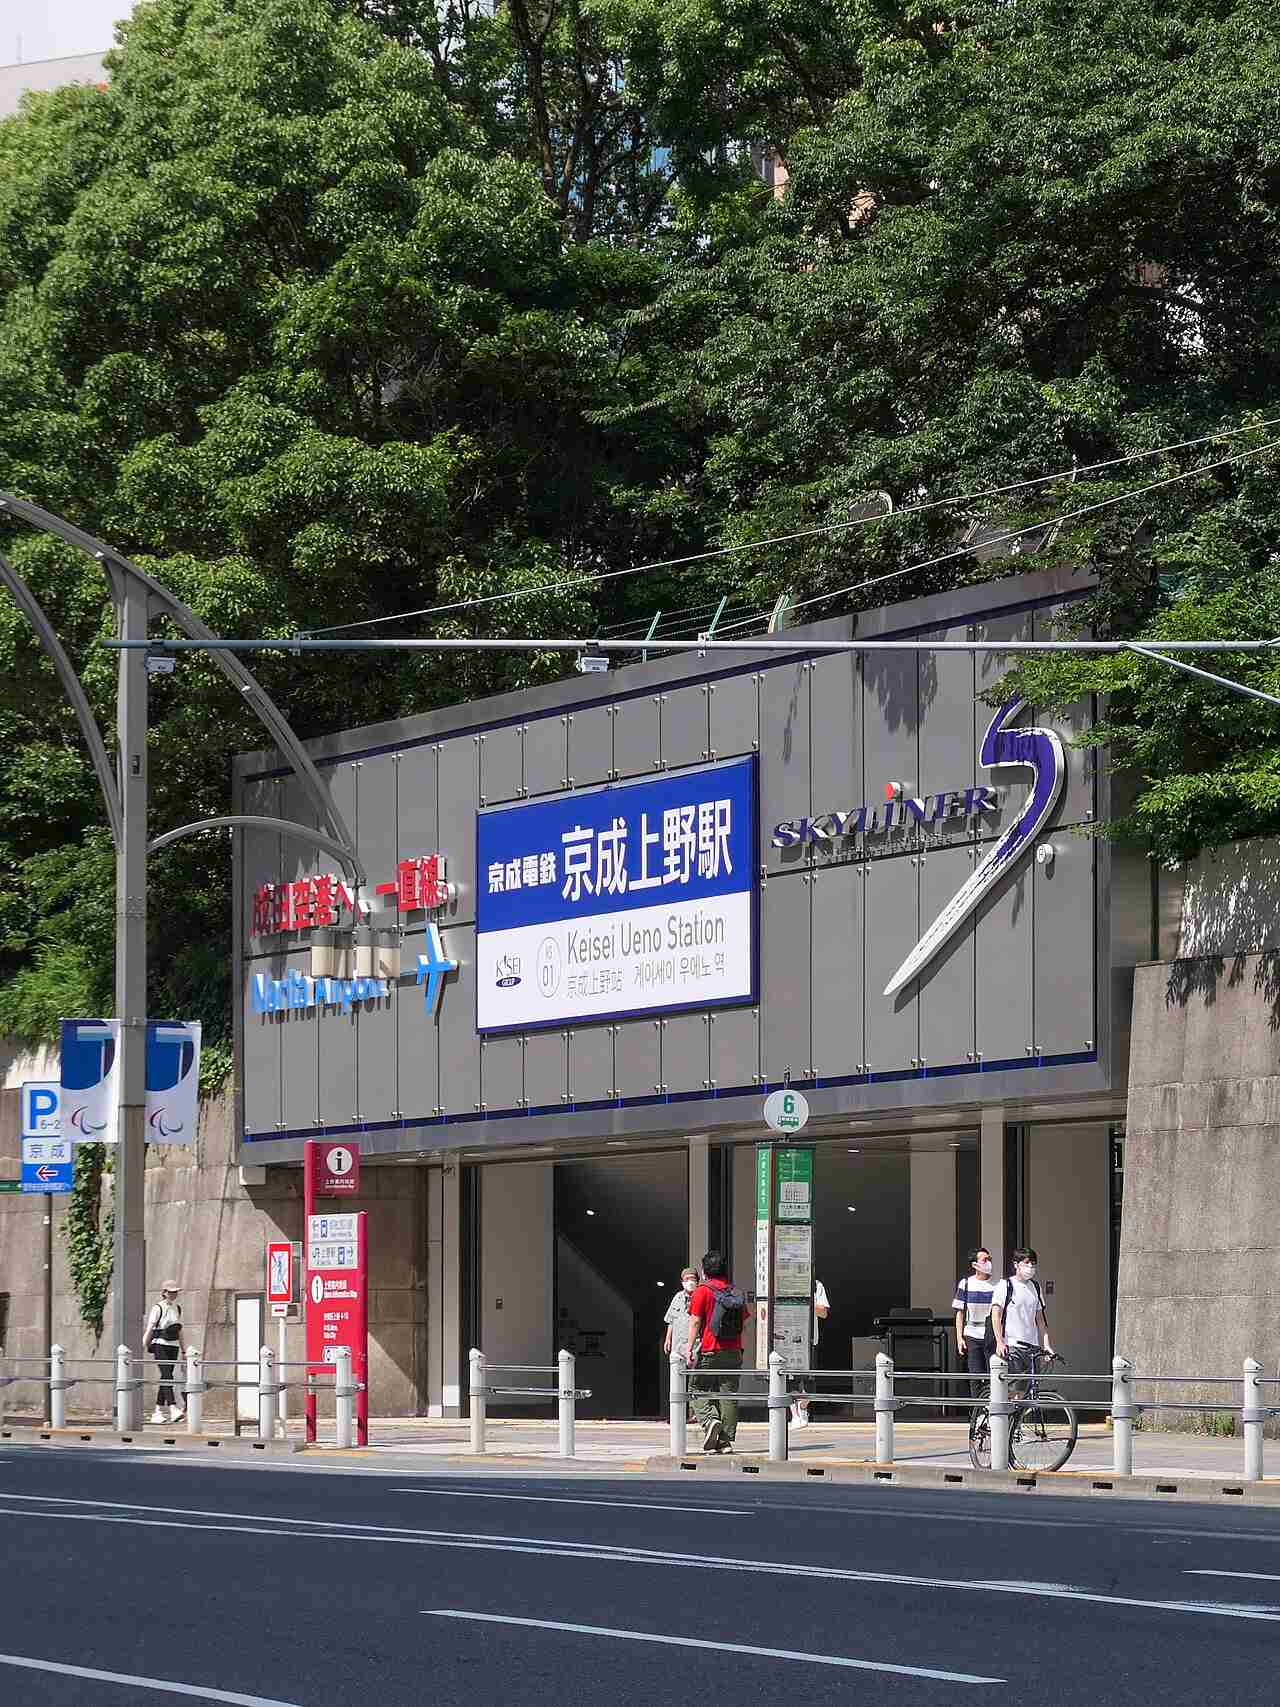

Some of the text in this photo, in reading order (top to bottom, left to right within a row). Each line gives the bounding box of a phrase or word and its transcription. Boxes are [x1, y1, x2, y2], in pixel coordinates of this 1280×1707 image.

[561, 799, 734, 902] 京成上野駅
[487, 850, 557, 894] 京成電鉄
[567, 909, 724, 965] Keisei Ueno Station
[543, 965, 554, 987] 01
[714, 952, 727, 978] 역
[30, 1089, 58, 1130] P
[783, 1094, 795, 1114] 6
